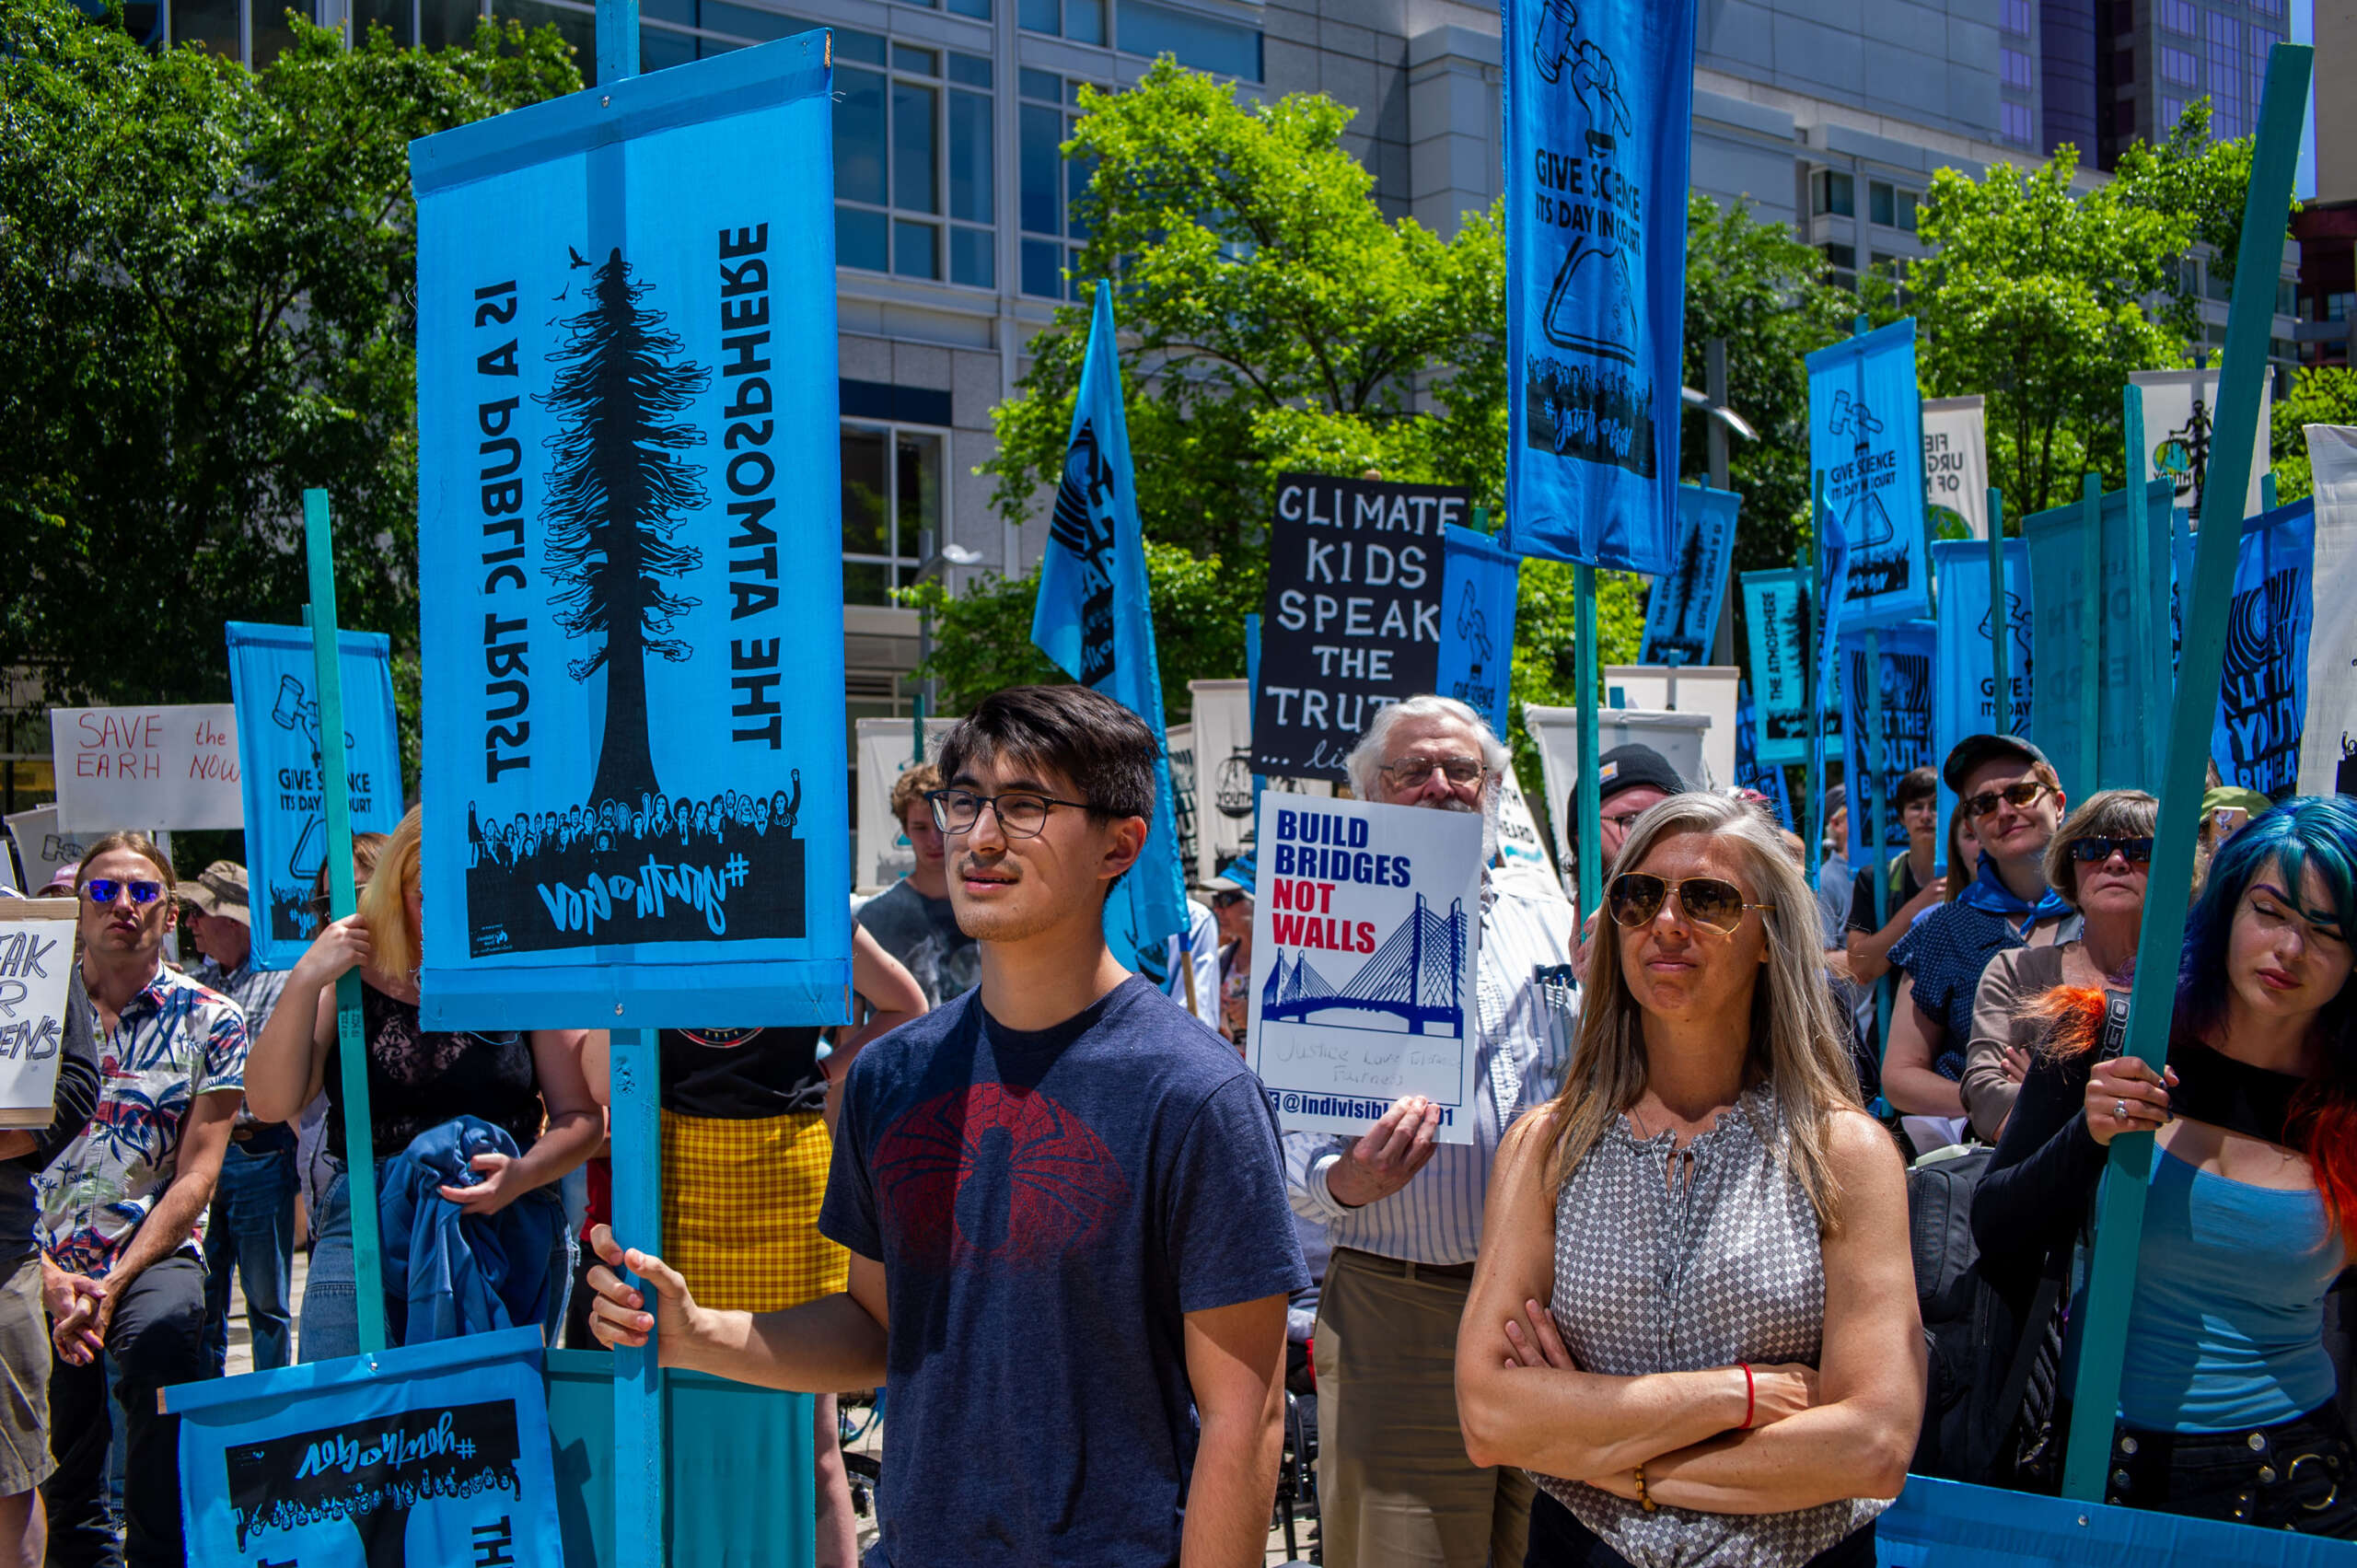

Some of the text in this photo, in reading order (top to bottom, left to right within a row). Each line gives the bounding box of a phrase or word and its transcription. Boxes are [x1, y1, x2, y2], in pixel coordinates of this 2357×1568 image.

[1535, 147, 1641, 223] GIVE SCIENCE
[1536, 192, 1552, 225] ITS
[1559, 200, 1595, 233] DAY
[1597, 210, 1614, 238] IN
[1830, 450, 1897, 483] GIVE SCIENCE
[1306, 538, 1427, 589] KIDS
[1277, 589, 1440, 643] SPEAK
[1312, 645, 1394, 680] THE
[1762, 591, 1782, 701] THE ATMOSPHERE
[79, 713, 226, 749] SAVE the
[1265, 686, 1400, 734] TRUT
[77, 752, 240, 783] EARH NOW
[278, 768, 371, 794] GIVE SNCE
[281, 795, 372, 814] ITS DAY URT
[1276, 809, 1369, 849] BUILD
[1274, 844, 1411, 889] BRIDGES
[1272, 878, 1336, 914] NOT
[1272, 913, 1376, 955] WALLS
[471, 1515, 516, 1568] TH
